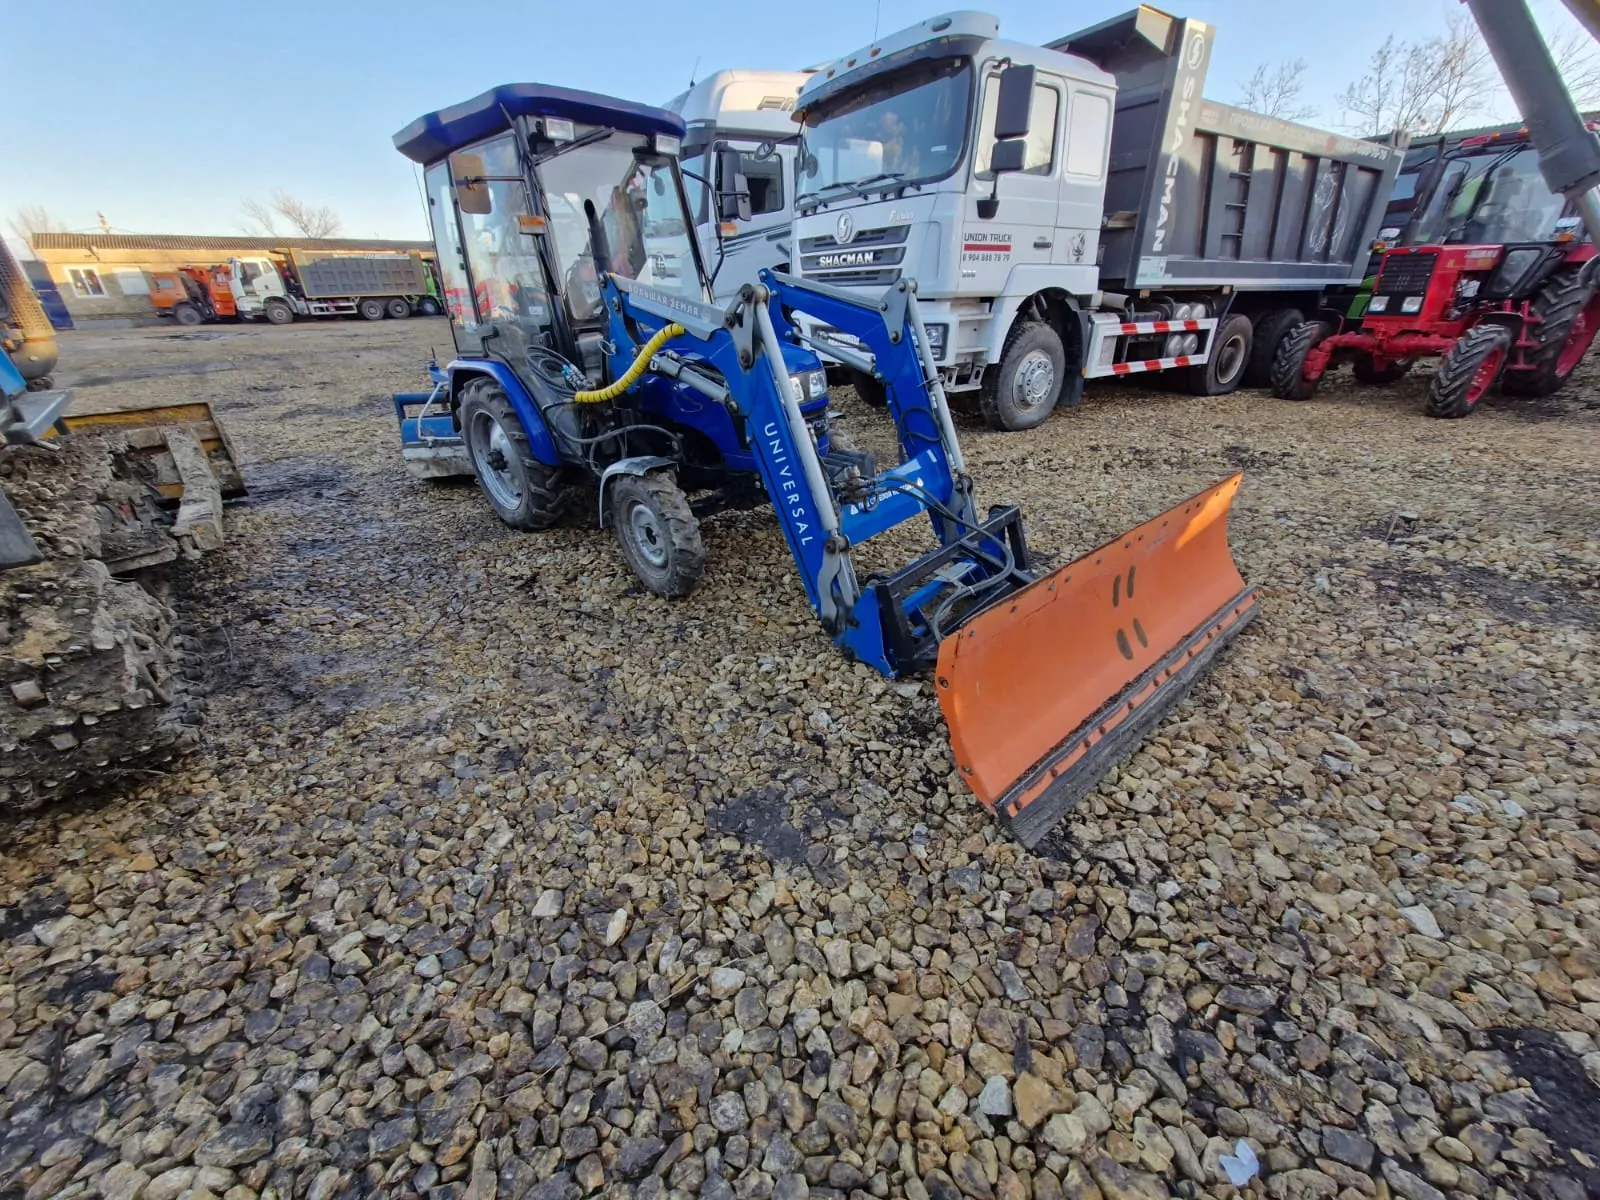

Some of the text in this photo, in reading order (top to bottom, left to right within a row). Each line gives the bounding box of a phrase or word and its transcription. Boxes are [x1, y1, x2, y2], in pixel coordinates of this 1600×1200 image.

[1152, 76, 1194, 252] SHACMAN
[964, 233, 1012, 242] UNION TRUCK
[820, 252, 874, 267] SHACMAN
[670, 299, 699, 316] ЗЕМЛЯ
[764, 422, 813, 546] UNIVERSAL
